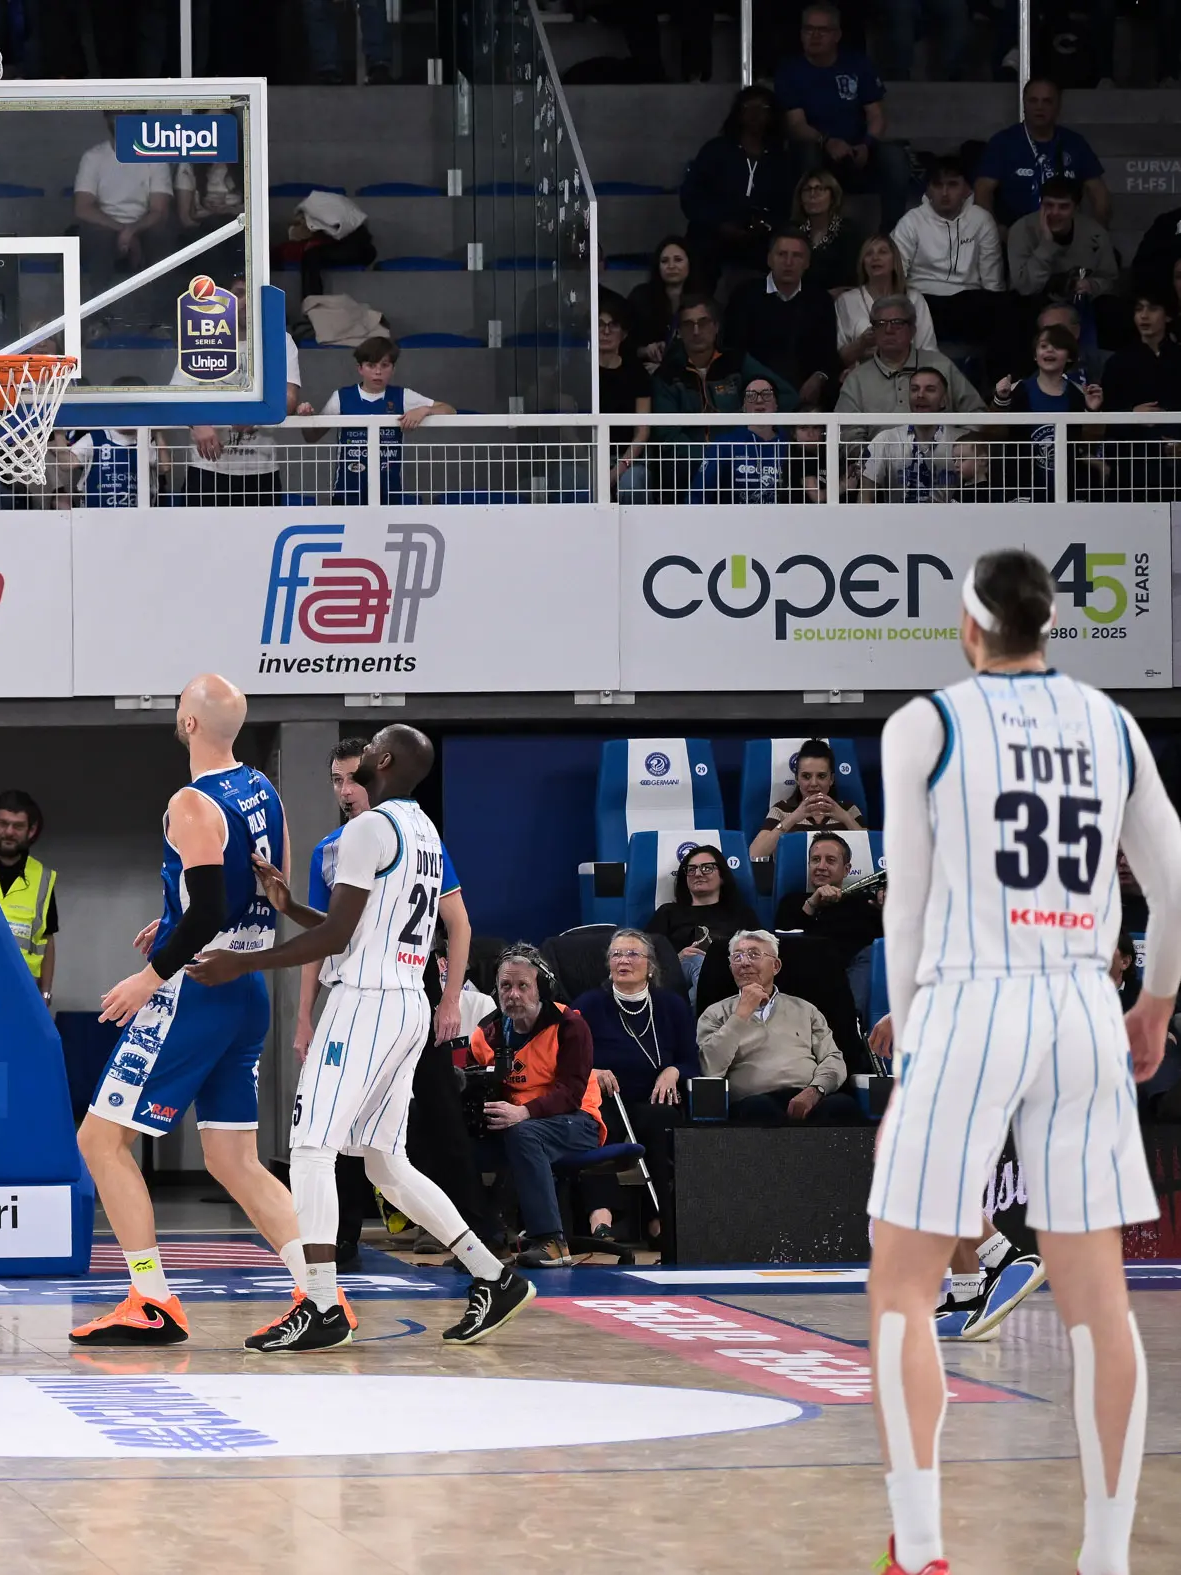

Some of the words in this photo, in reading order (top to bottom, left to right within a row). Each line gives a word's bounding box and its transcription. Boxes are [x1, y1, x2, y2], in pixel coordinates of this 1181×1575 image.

[141, 121, 218, 156] Unipol
[187, 319, 232, 336] LBA
[192, 354, 228, 371] Unipol
[1050, 542, 1128, 624] 45
[1134, 552, 1150, 617] YEARS
[793, 628, 882, 642] SOLUZIONI
[1049, 627, 1078, 640] 980
[1091, 627, 1128, 639] 2025
[258, 652, 417, 674] investments
[1007, 741, 1093, 788] TOTÈ
[994, 790, 1103, 896] 35
[729, 859, 738, 867] 17
[1010, 908, 1096, 931] KIMBO
[140, 1101, 179, 1119] XRAY
